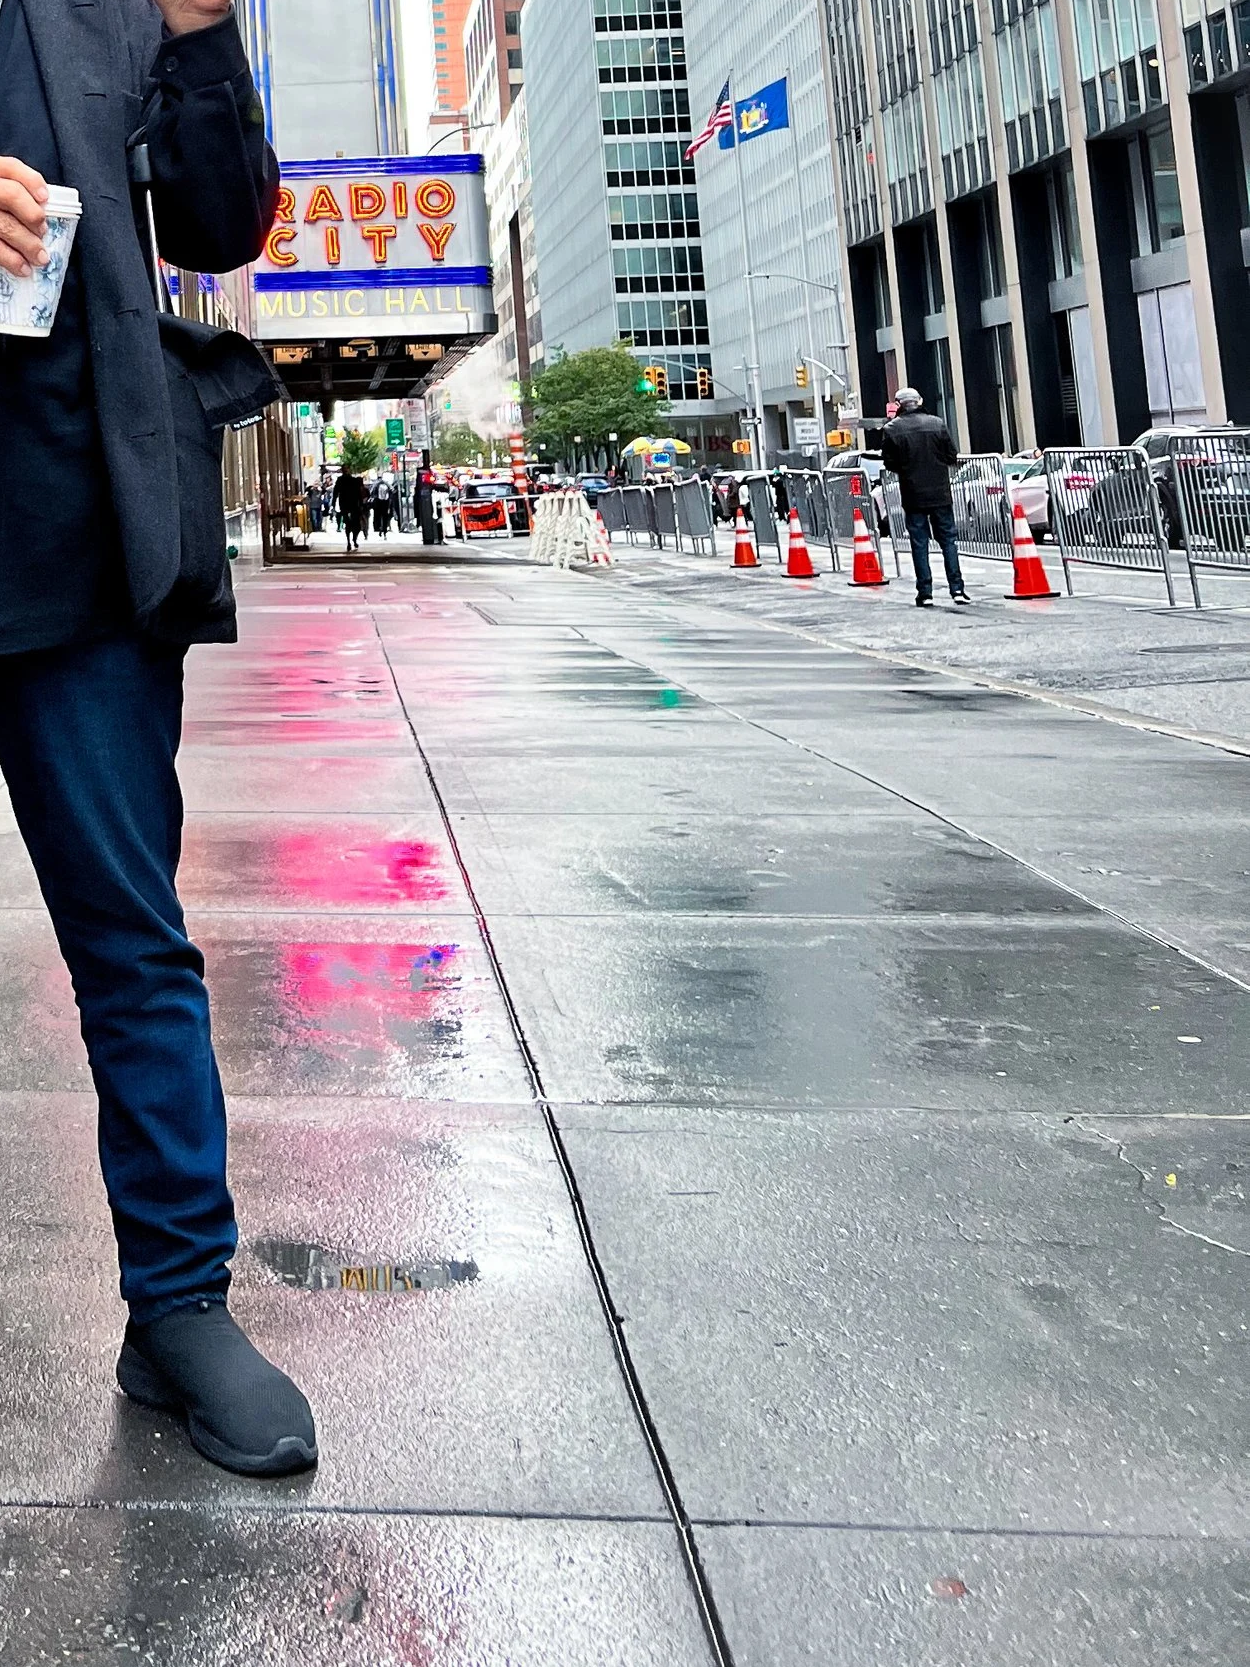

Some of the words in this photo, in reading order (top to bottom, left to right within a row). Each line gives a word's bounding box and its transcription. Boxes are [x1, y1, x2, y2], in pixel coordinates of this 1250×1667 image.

[275, 179, 456, 223] RADIO
[265, 222, 456, 267] CITY
[258, 289, 365, 318] MUSIC
[385, 286, 472, 314] HALL
